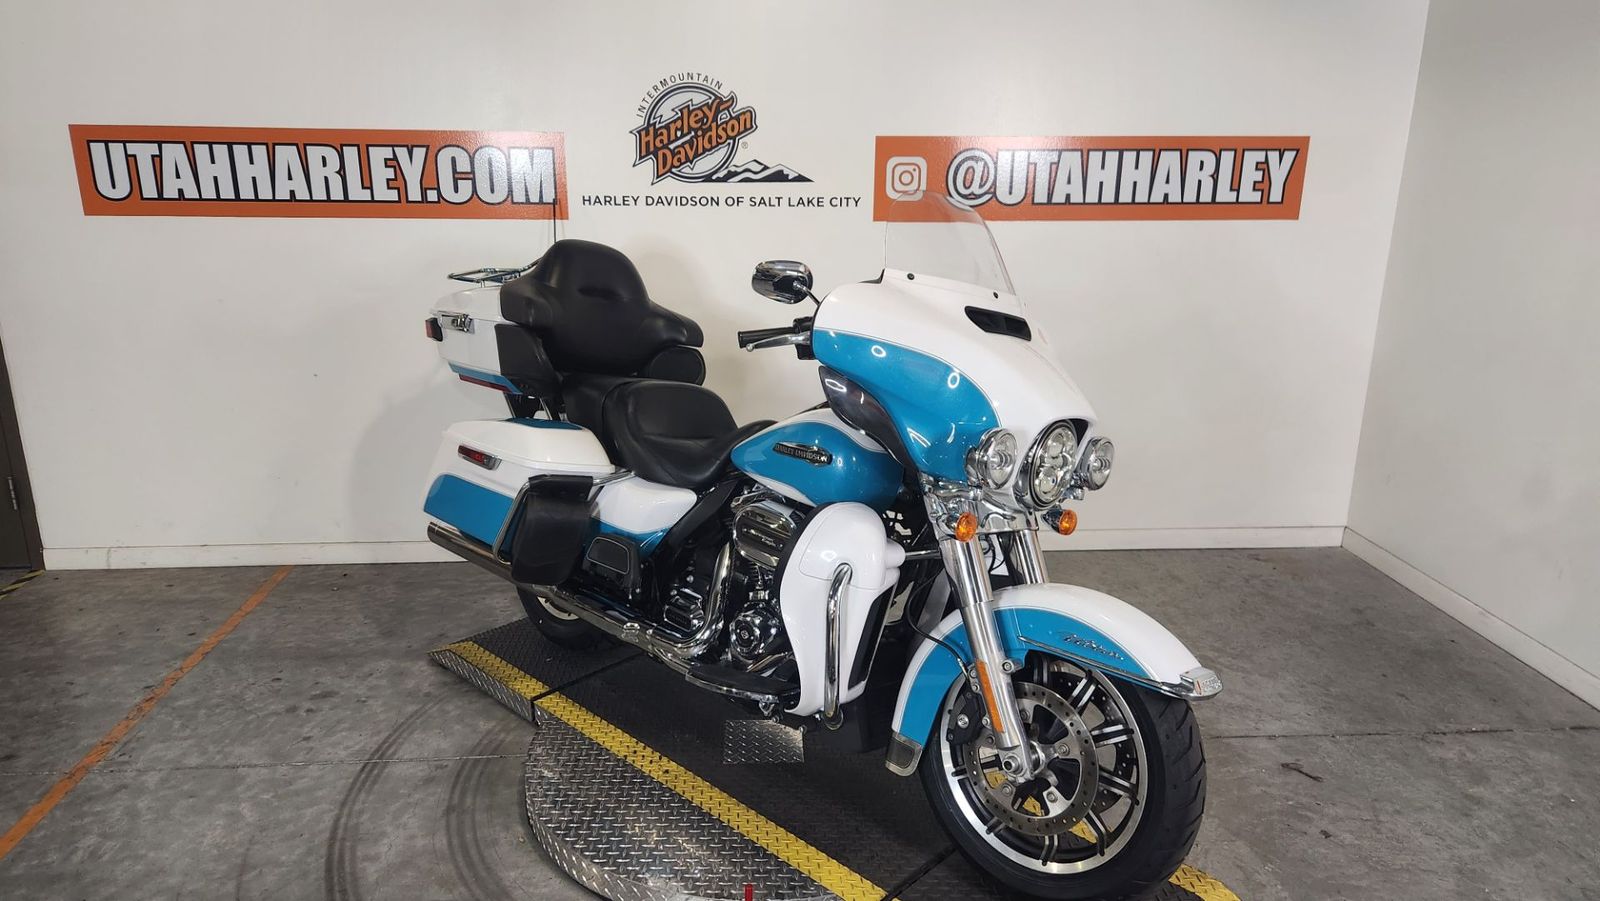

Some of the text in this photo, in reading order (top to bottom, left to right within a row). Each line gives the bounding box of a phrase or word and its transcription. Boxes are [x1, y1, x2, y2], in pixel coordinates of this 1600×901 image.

[636, 72, 723, 118] INTERMOUNTAIN
[87, 140, 558, 206] UTAHHARLEY.COM
[656, 109, 753, 178] Davidson
[582, 195, 862, 208] HARLEY DAVIDSON OF SALT LAKE CITY
[945, 147, 1300, 210] @UTAHHARLEY
